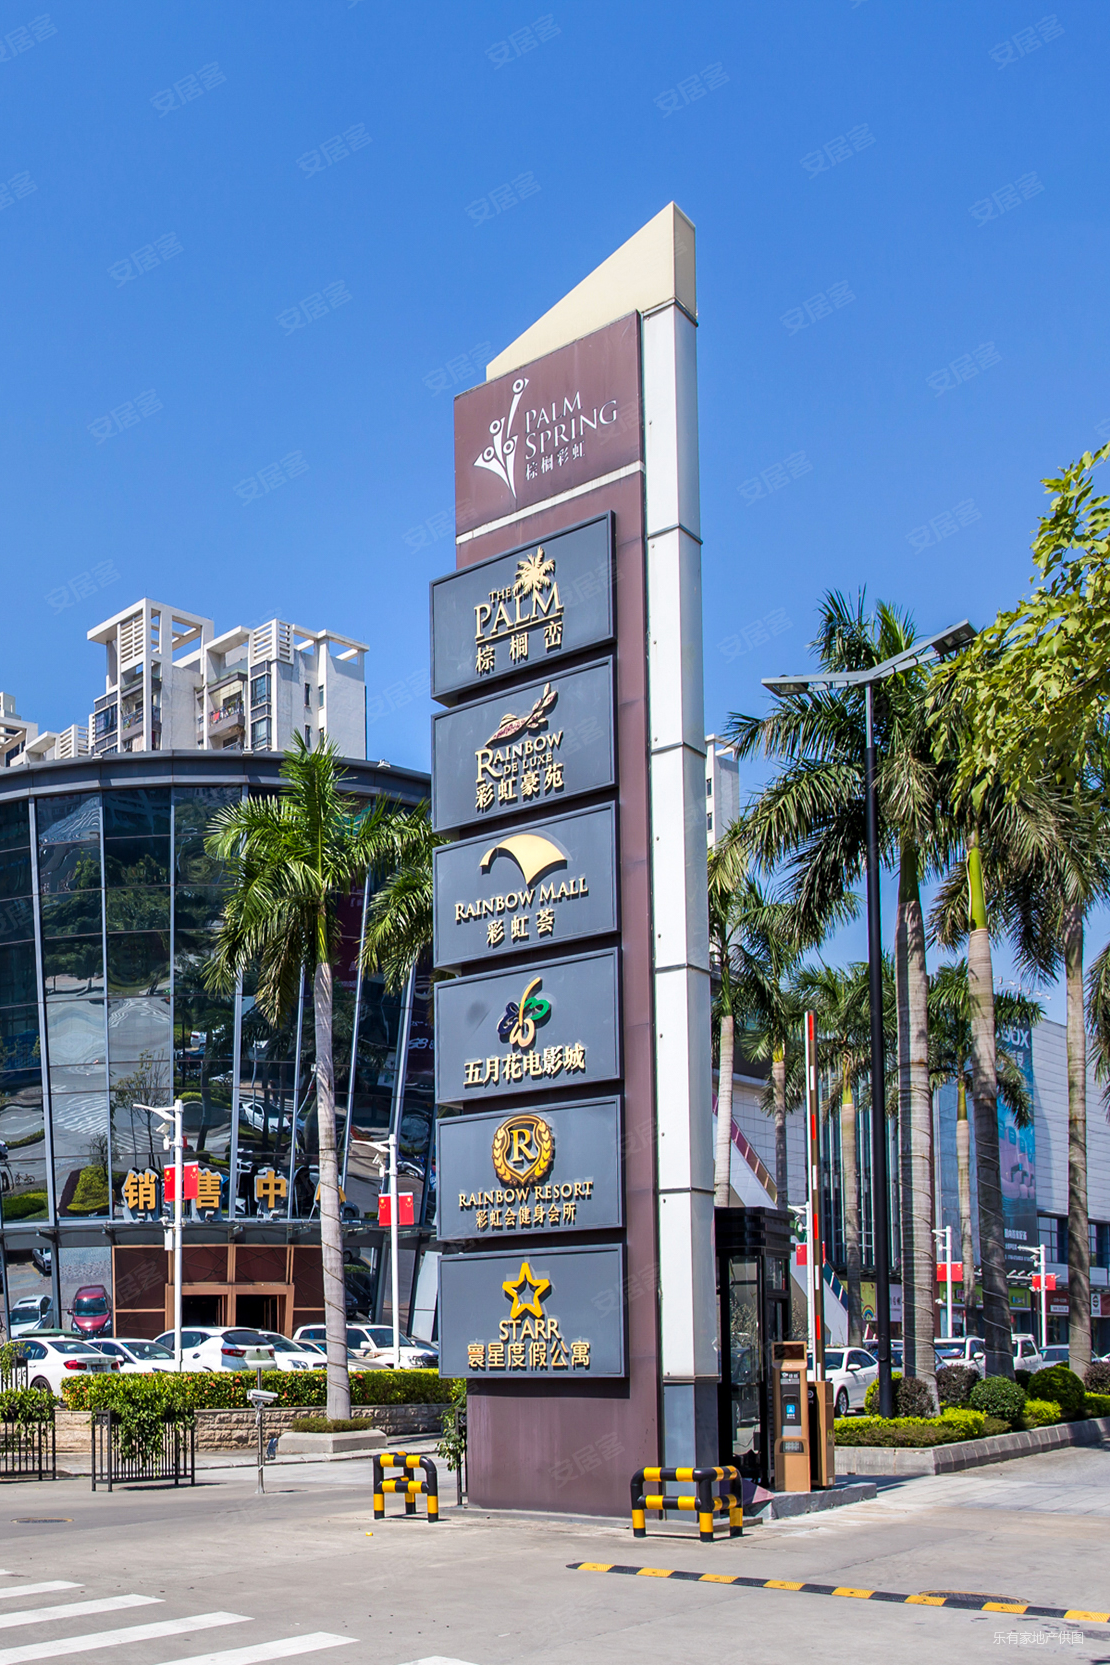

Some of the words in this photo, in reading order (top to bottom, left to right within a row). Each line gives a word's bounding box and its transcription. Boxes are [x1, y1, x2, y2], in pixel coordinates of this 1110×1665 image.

[525, 390, 583, 434] PALM
[525, 399, 617, 460] SPRING
[525, 440, 585, 481] 棕榈彩虹
[473, 581, 564, 640] PALM
[488, 585, 513, 604] THE
[475, 620, 563, 673] 棕榈峦
[475, 730, 563, 783] RAINBOW
[503, 762, 518, 775] DE
[522, 752, 553, 769] LUXE
[475, 763, 564, 809] 彩虹豪苑
[454, 888, 535, 921] RAINBOW
[538, 877, 589, 902] MALL
[486, 907, 555, 945] 彩虹荟
[463, 1042, 586, 1085] 五月花电影城
[510, 1128, 536, 1162] R
[124, 1170, 347, 1211] 销售中
[458, 1187, 530, 1208] RAINBOW
[534, 1181, 594, 1201] RESORT
[476, 1202, 576, 1228] 彩虹会健身会所
[498, 1318, 561, 1341] STARR
[467, 1340, 590, 1368] 寰星度假公寓
